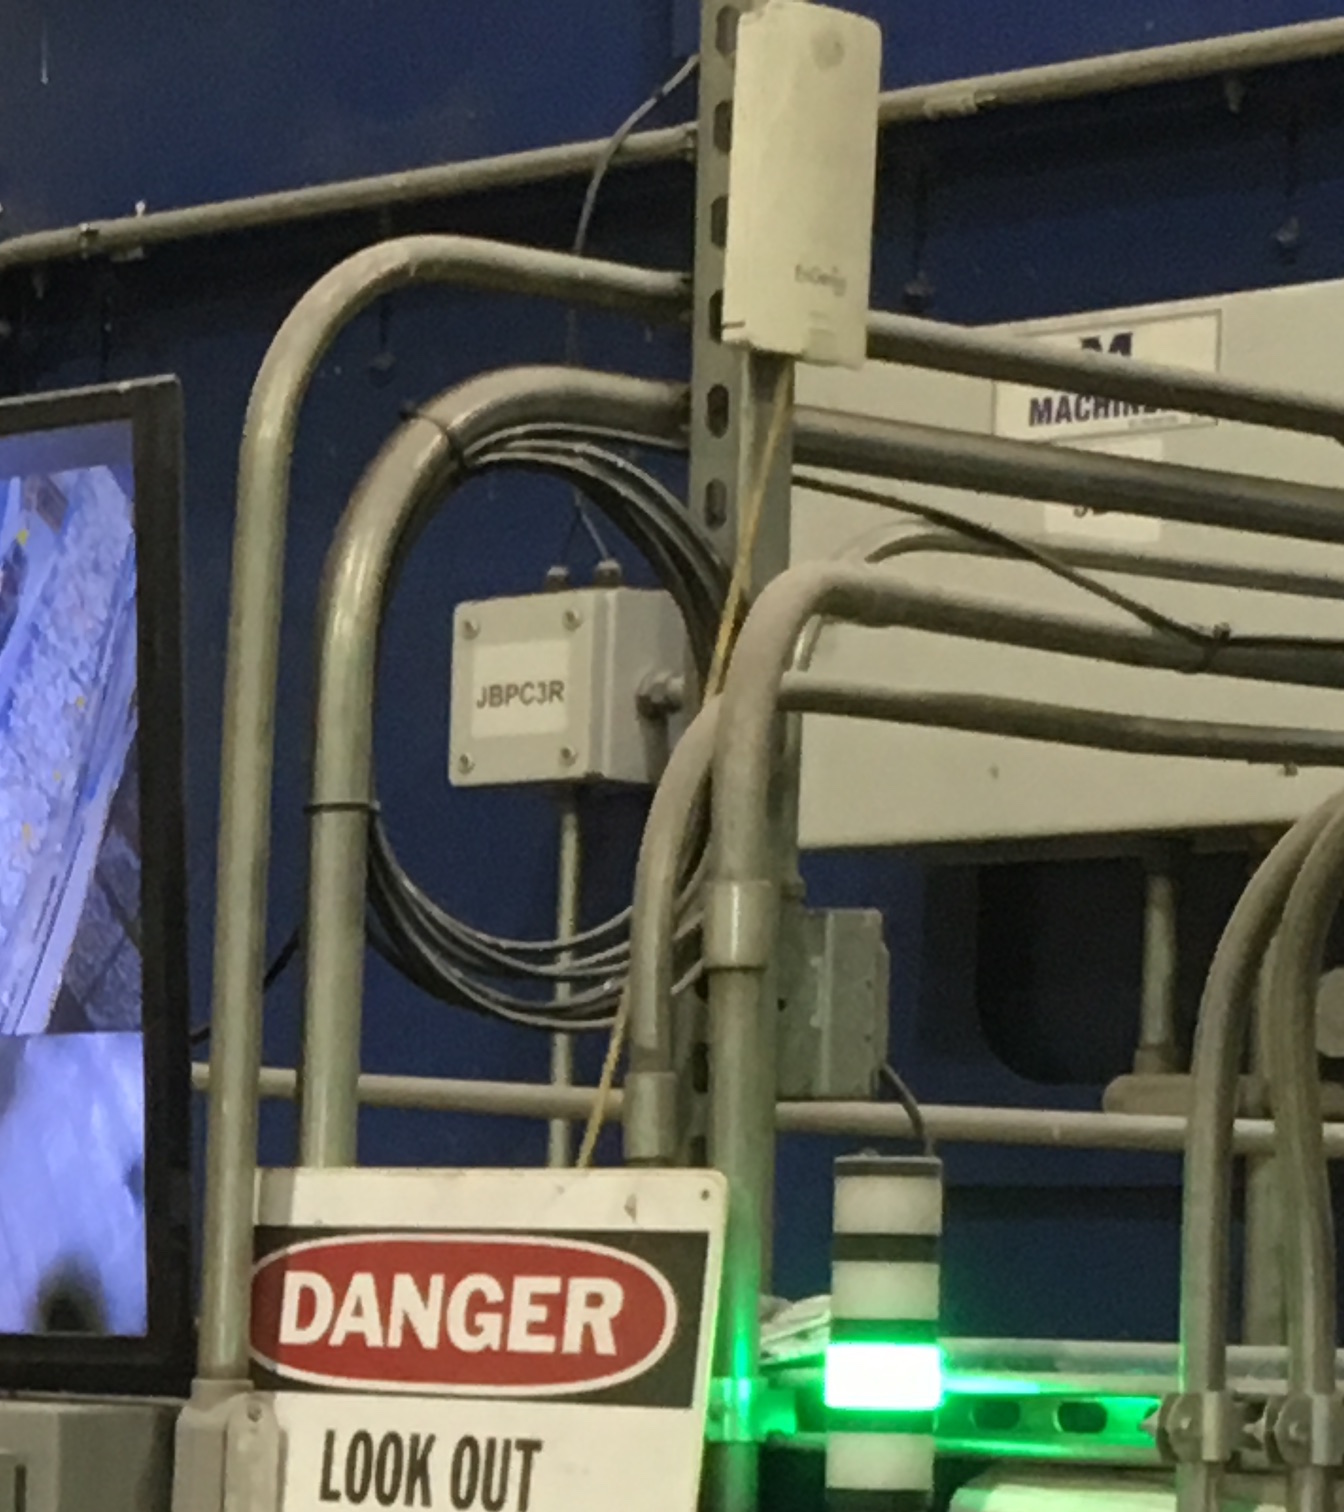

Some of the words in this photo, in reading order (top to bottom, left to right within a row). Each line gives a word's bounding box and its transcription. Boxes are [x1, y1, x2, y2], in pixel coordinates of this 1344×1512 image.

[476, 680, 567, 709] JBPC3R
[279, 1269, 625, 1358] DANGER
[319, 1428, 437, 1508] LOOK
